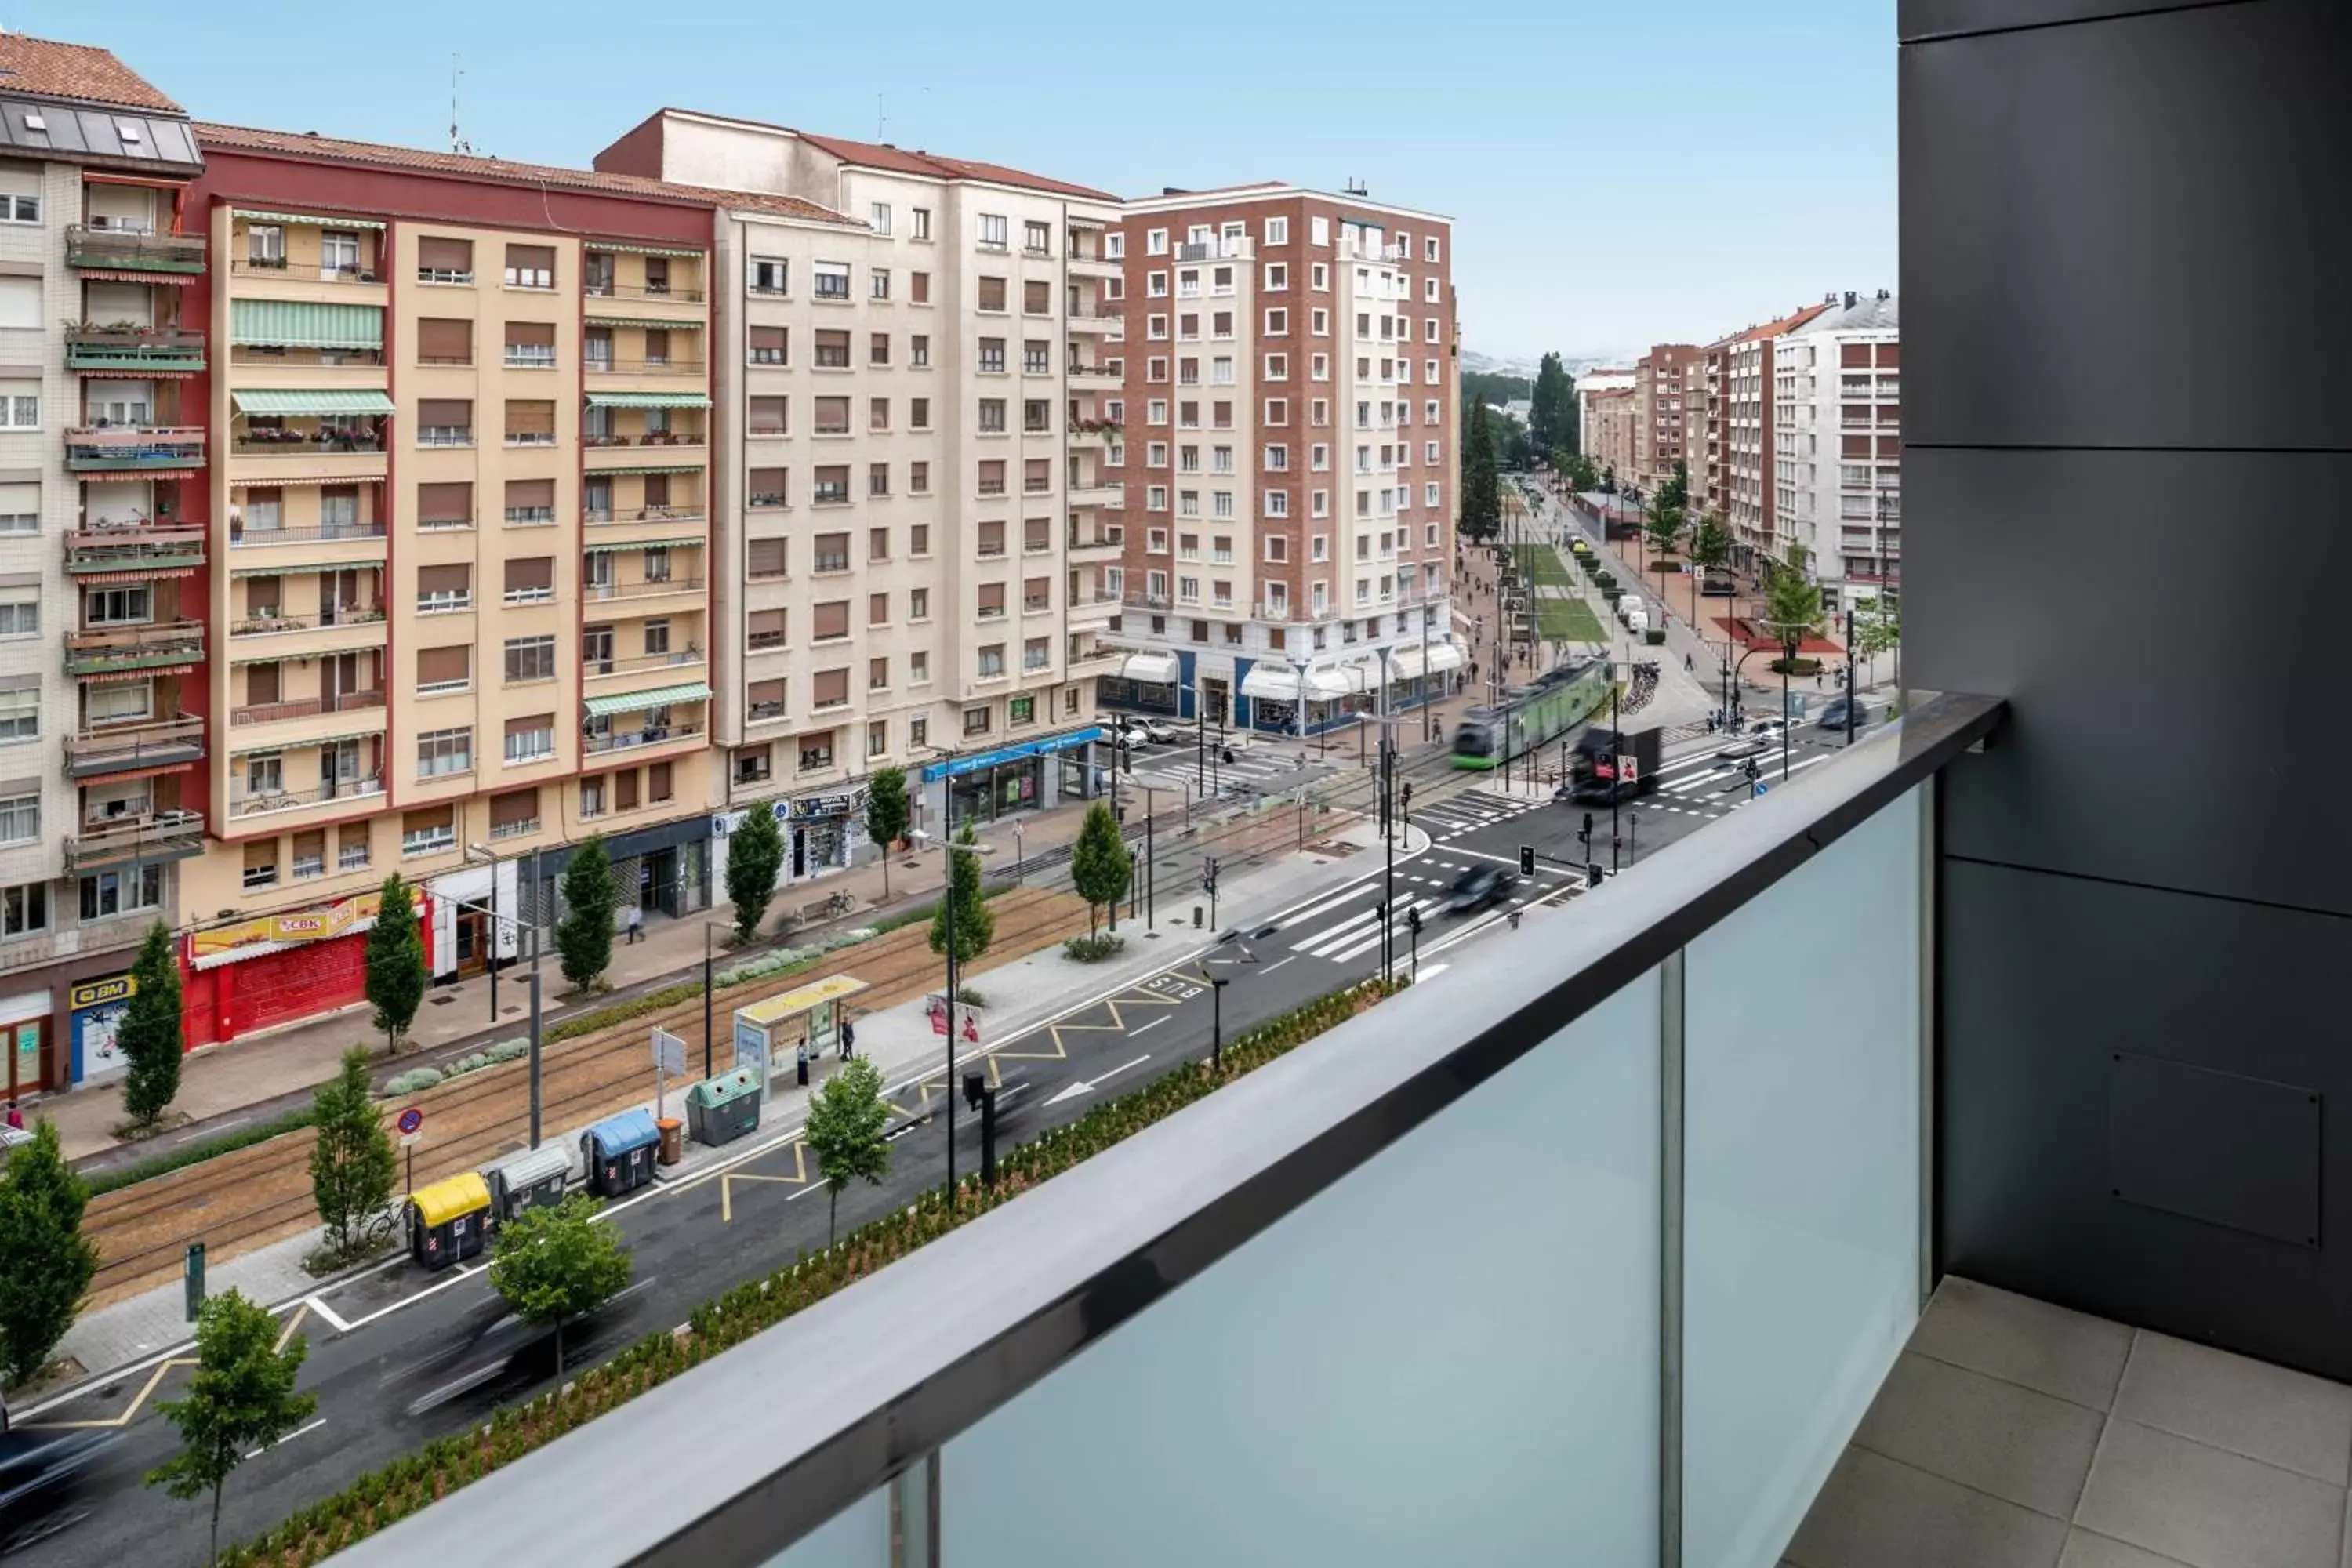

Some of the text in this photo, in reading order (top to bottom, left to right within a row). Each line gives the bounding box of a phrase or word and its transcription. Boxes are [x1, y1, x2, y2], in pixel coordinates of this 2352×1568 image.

[291, 919, 318, 930] CBK
[97, 982, 125, 998] BM
[1147, 977, 1203, 998] BUS
